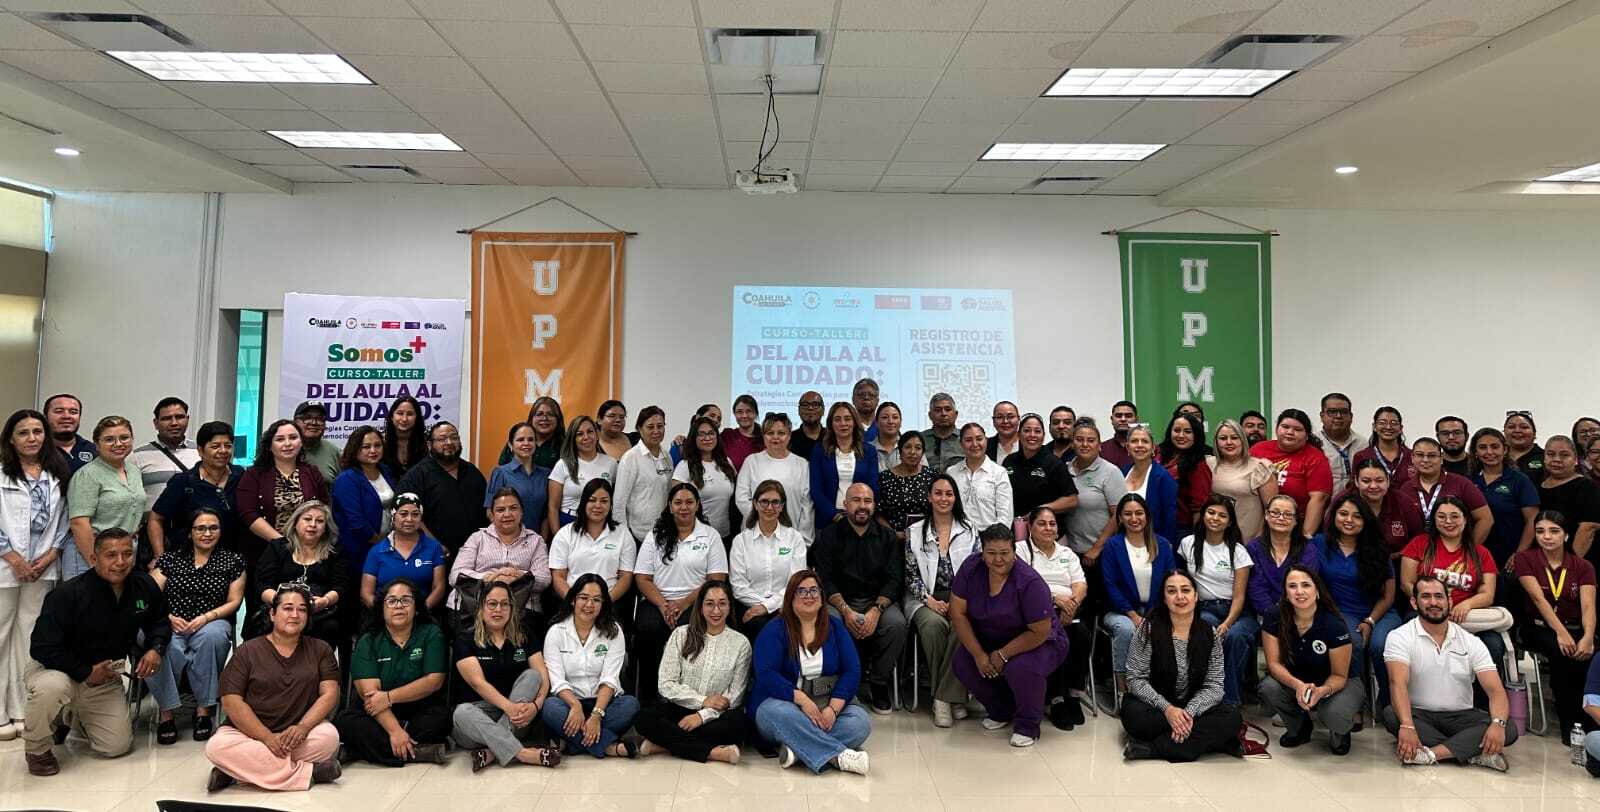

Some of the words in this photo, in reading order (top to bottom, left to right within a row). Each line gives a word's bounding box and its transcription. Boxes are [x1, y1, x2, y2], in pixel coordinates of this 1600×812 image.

[763, 328, 867, 340] CURSO-TALLER:
[909, 329, 980, 341] REGISTRO
[983, 330, 1004, 342] DE
[910, 342, 1005, 356] ASISTENCIA
[1176, 258, 1215, 432] UPM
[746, 344, 788, 361] DEL
[793, 345, 855, 362] AULA
[858, 346, 887, 362] AL
[328, 369, 424, 379] CURSO-TALLER:
[745, 364, 885, 386] CUIDADO:
[306, 383, 349, 399] DEL
[353, 383, 409, 399] AULA
[413, 384, 442, 399] AL
